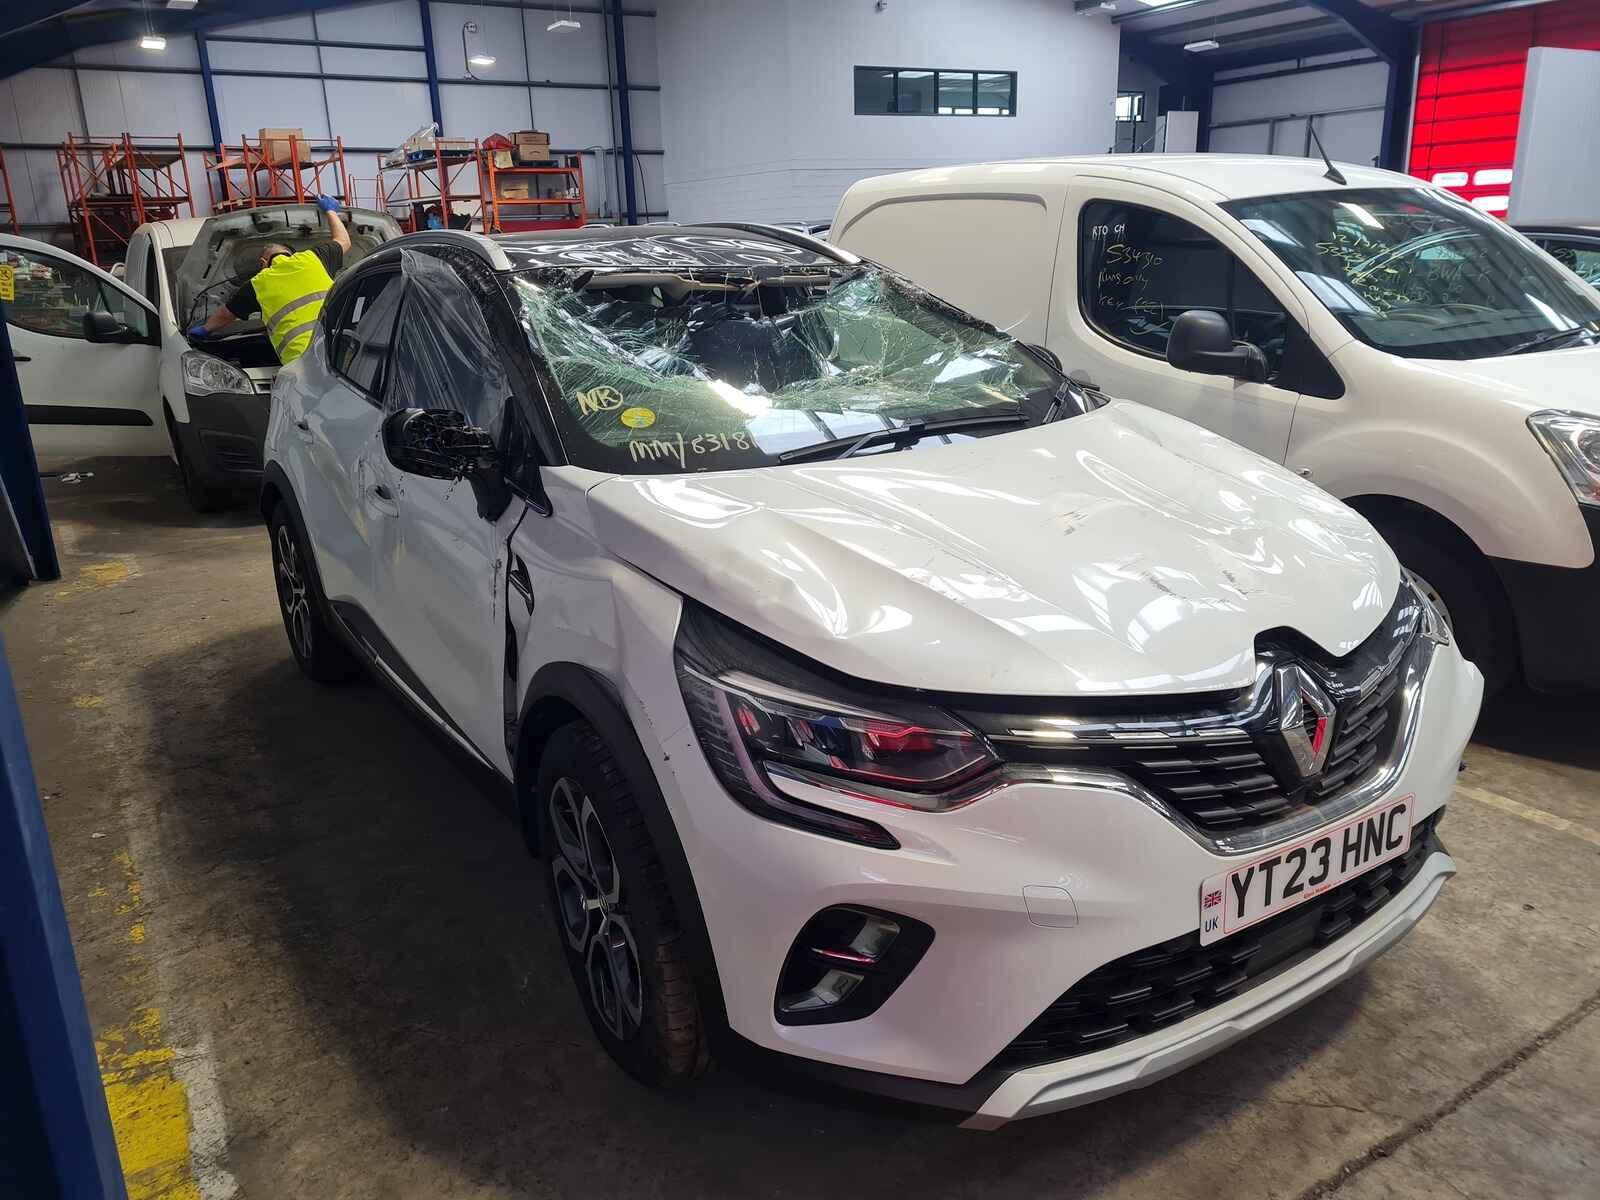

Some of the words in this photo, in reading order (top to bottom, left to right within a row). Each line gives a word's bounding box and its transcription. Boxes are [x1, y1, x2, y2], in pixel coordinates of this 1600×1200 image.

[1231, 836, 1332, 919] YT23
[1340, 803, 1407, 874] HNC
[1204, 916, 1219, 933] UK
